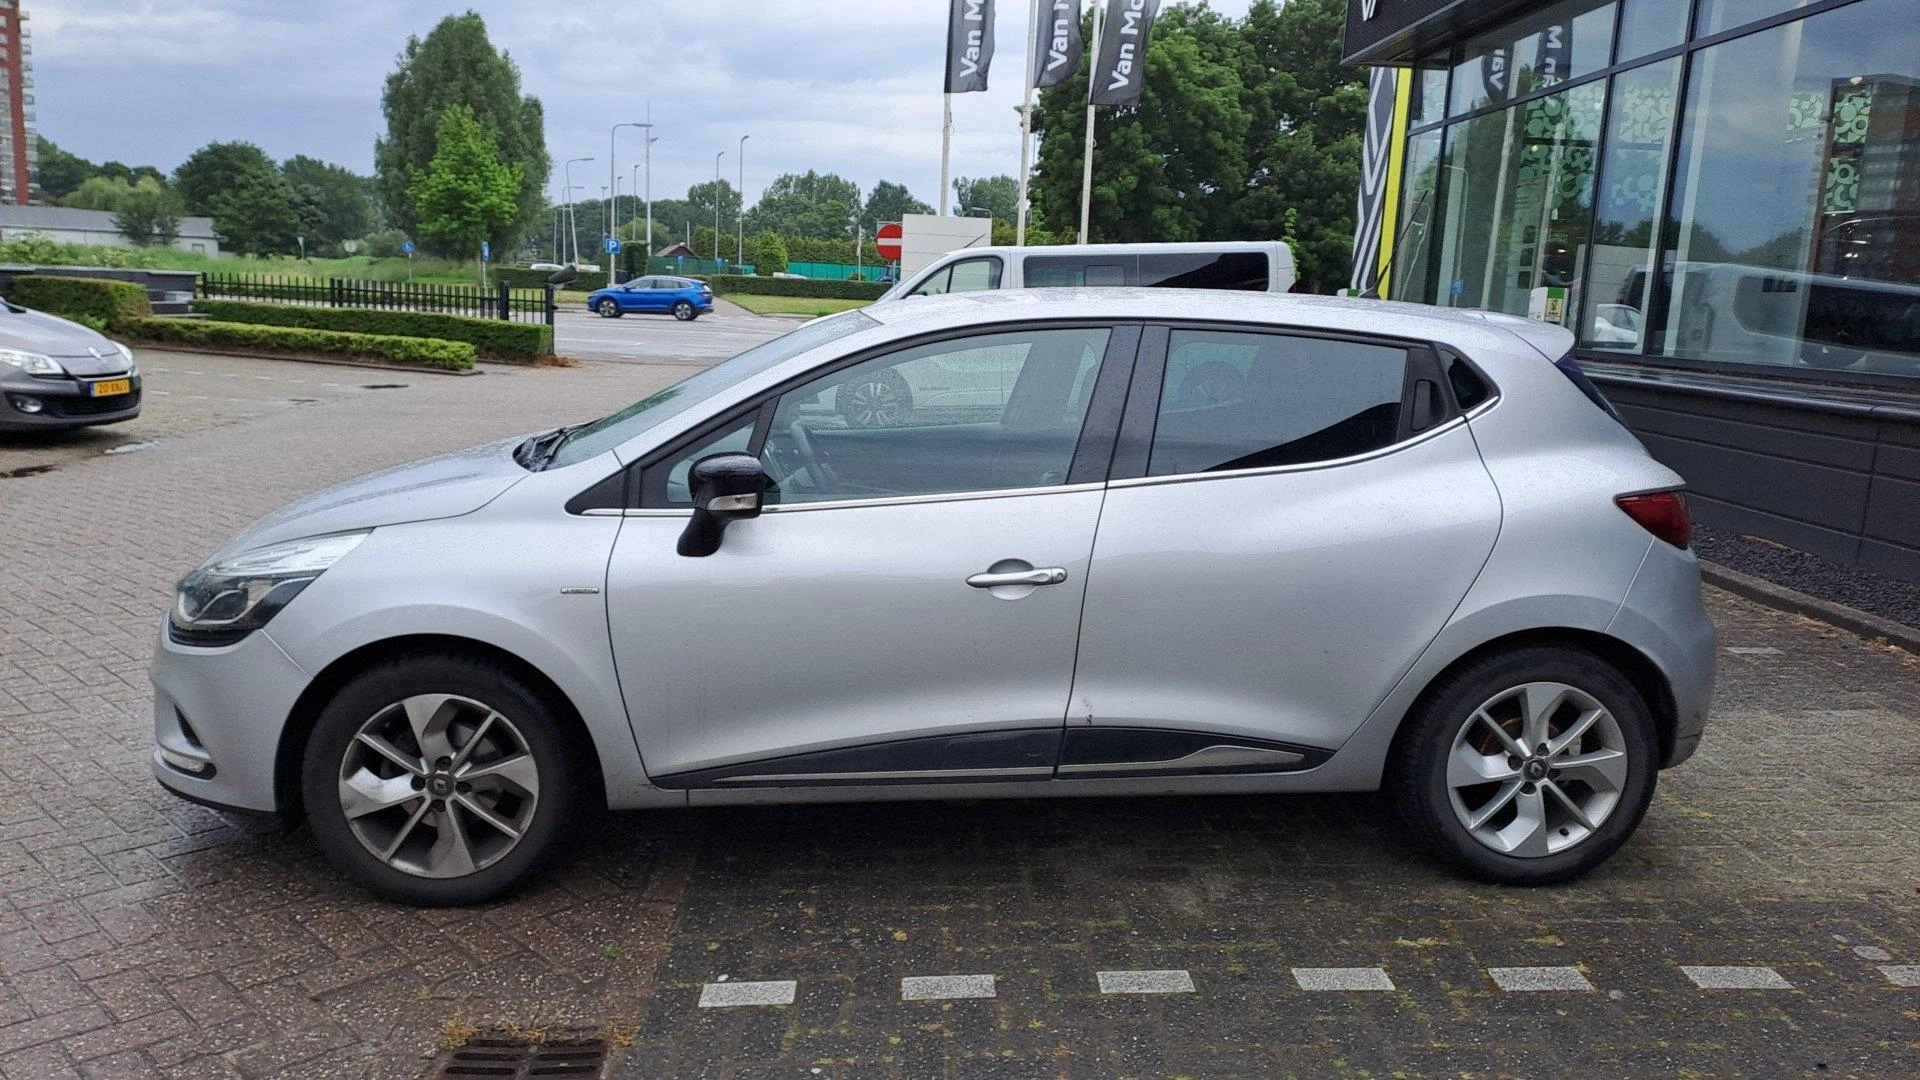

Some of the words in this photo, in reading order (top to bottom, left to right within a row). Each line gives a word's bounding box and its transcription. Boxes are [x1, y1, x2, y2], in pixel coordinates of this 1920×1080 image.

[960, 29, 982, 78] Van
[1047, 18, 1069, 71] Van
[1108, 43, 1135, 91] Van
[609, 240, 618, 252] P
